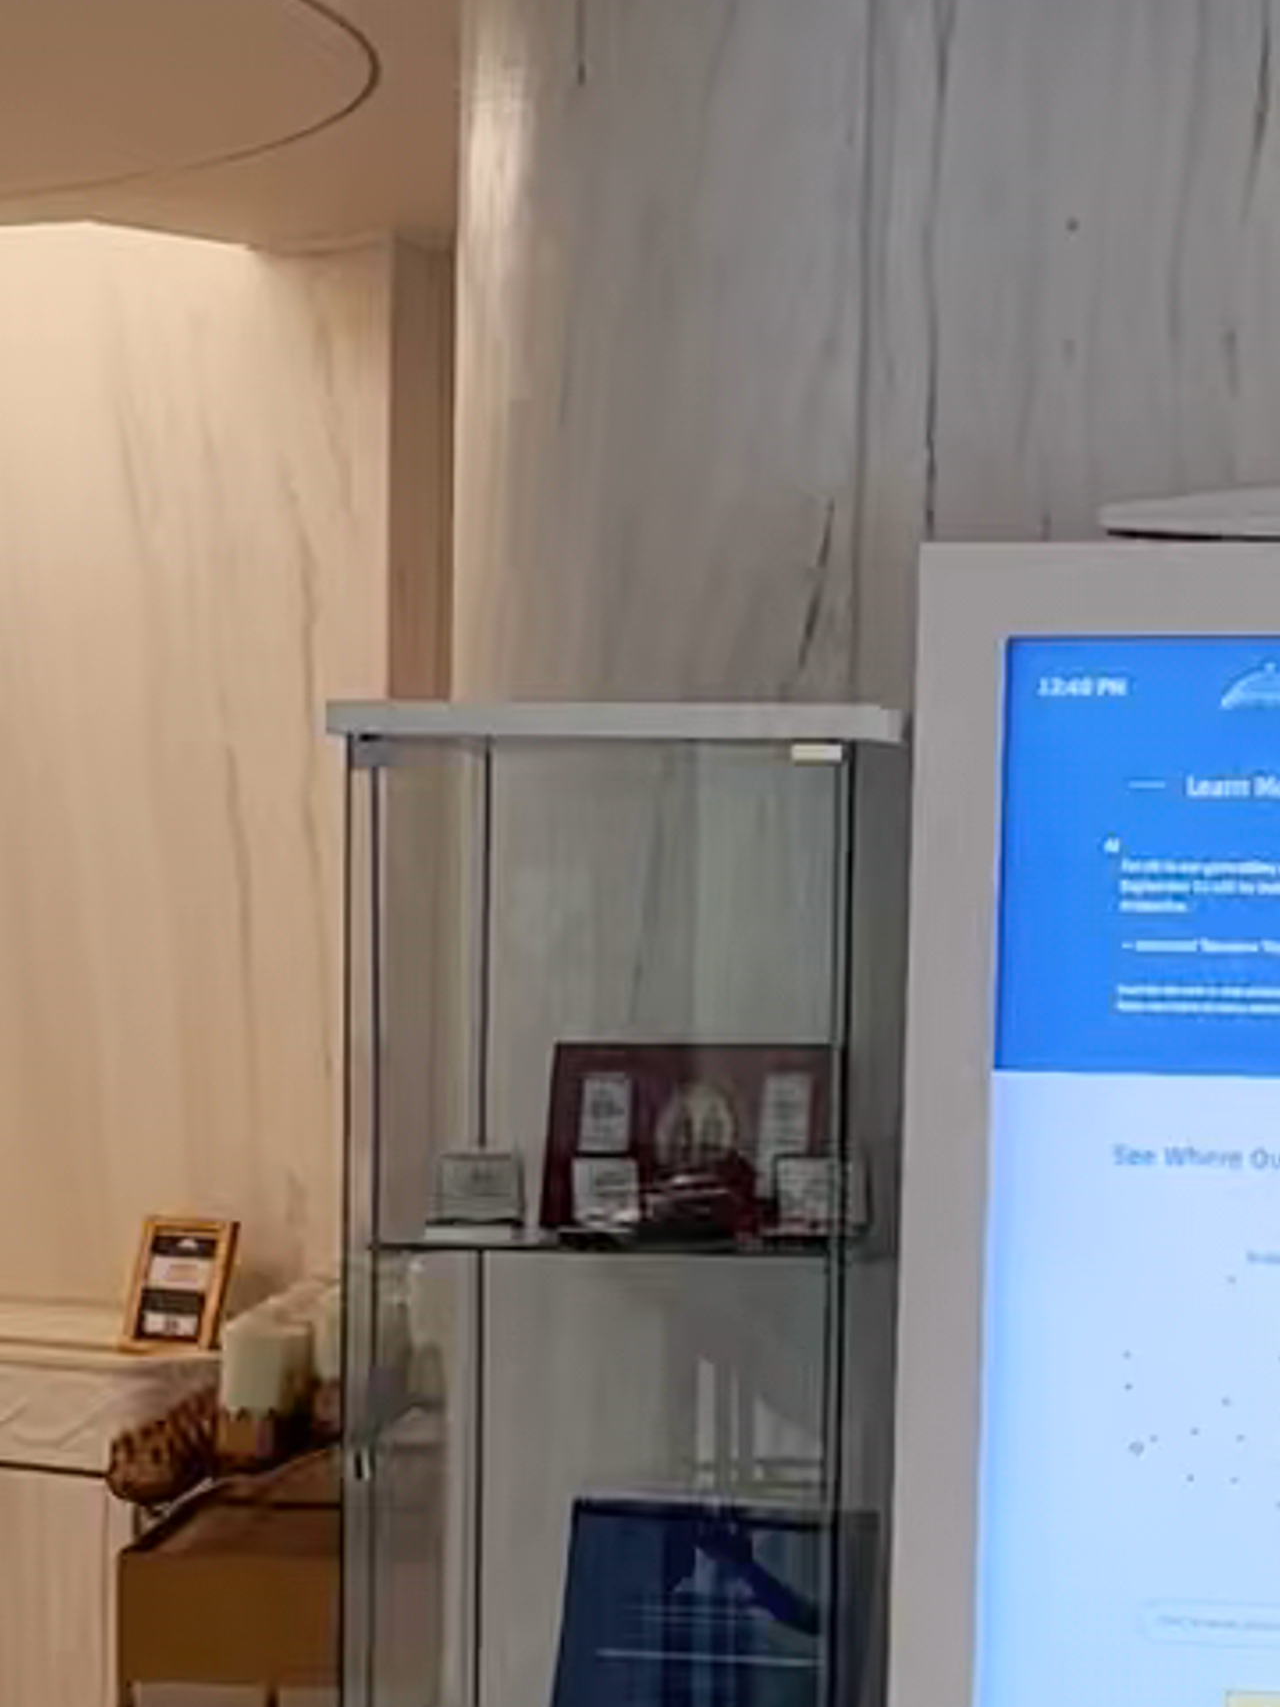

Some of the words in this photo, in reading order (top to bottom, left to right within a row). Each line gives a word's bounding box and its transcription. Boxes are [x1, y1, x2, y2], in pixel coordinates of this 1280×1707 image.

[1186, 776, 1251, 798] Learn
[1114, 1144, 1155, 1166] See
[1163, 1146, 1244, 1169] Where
